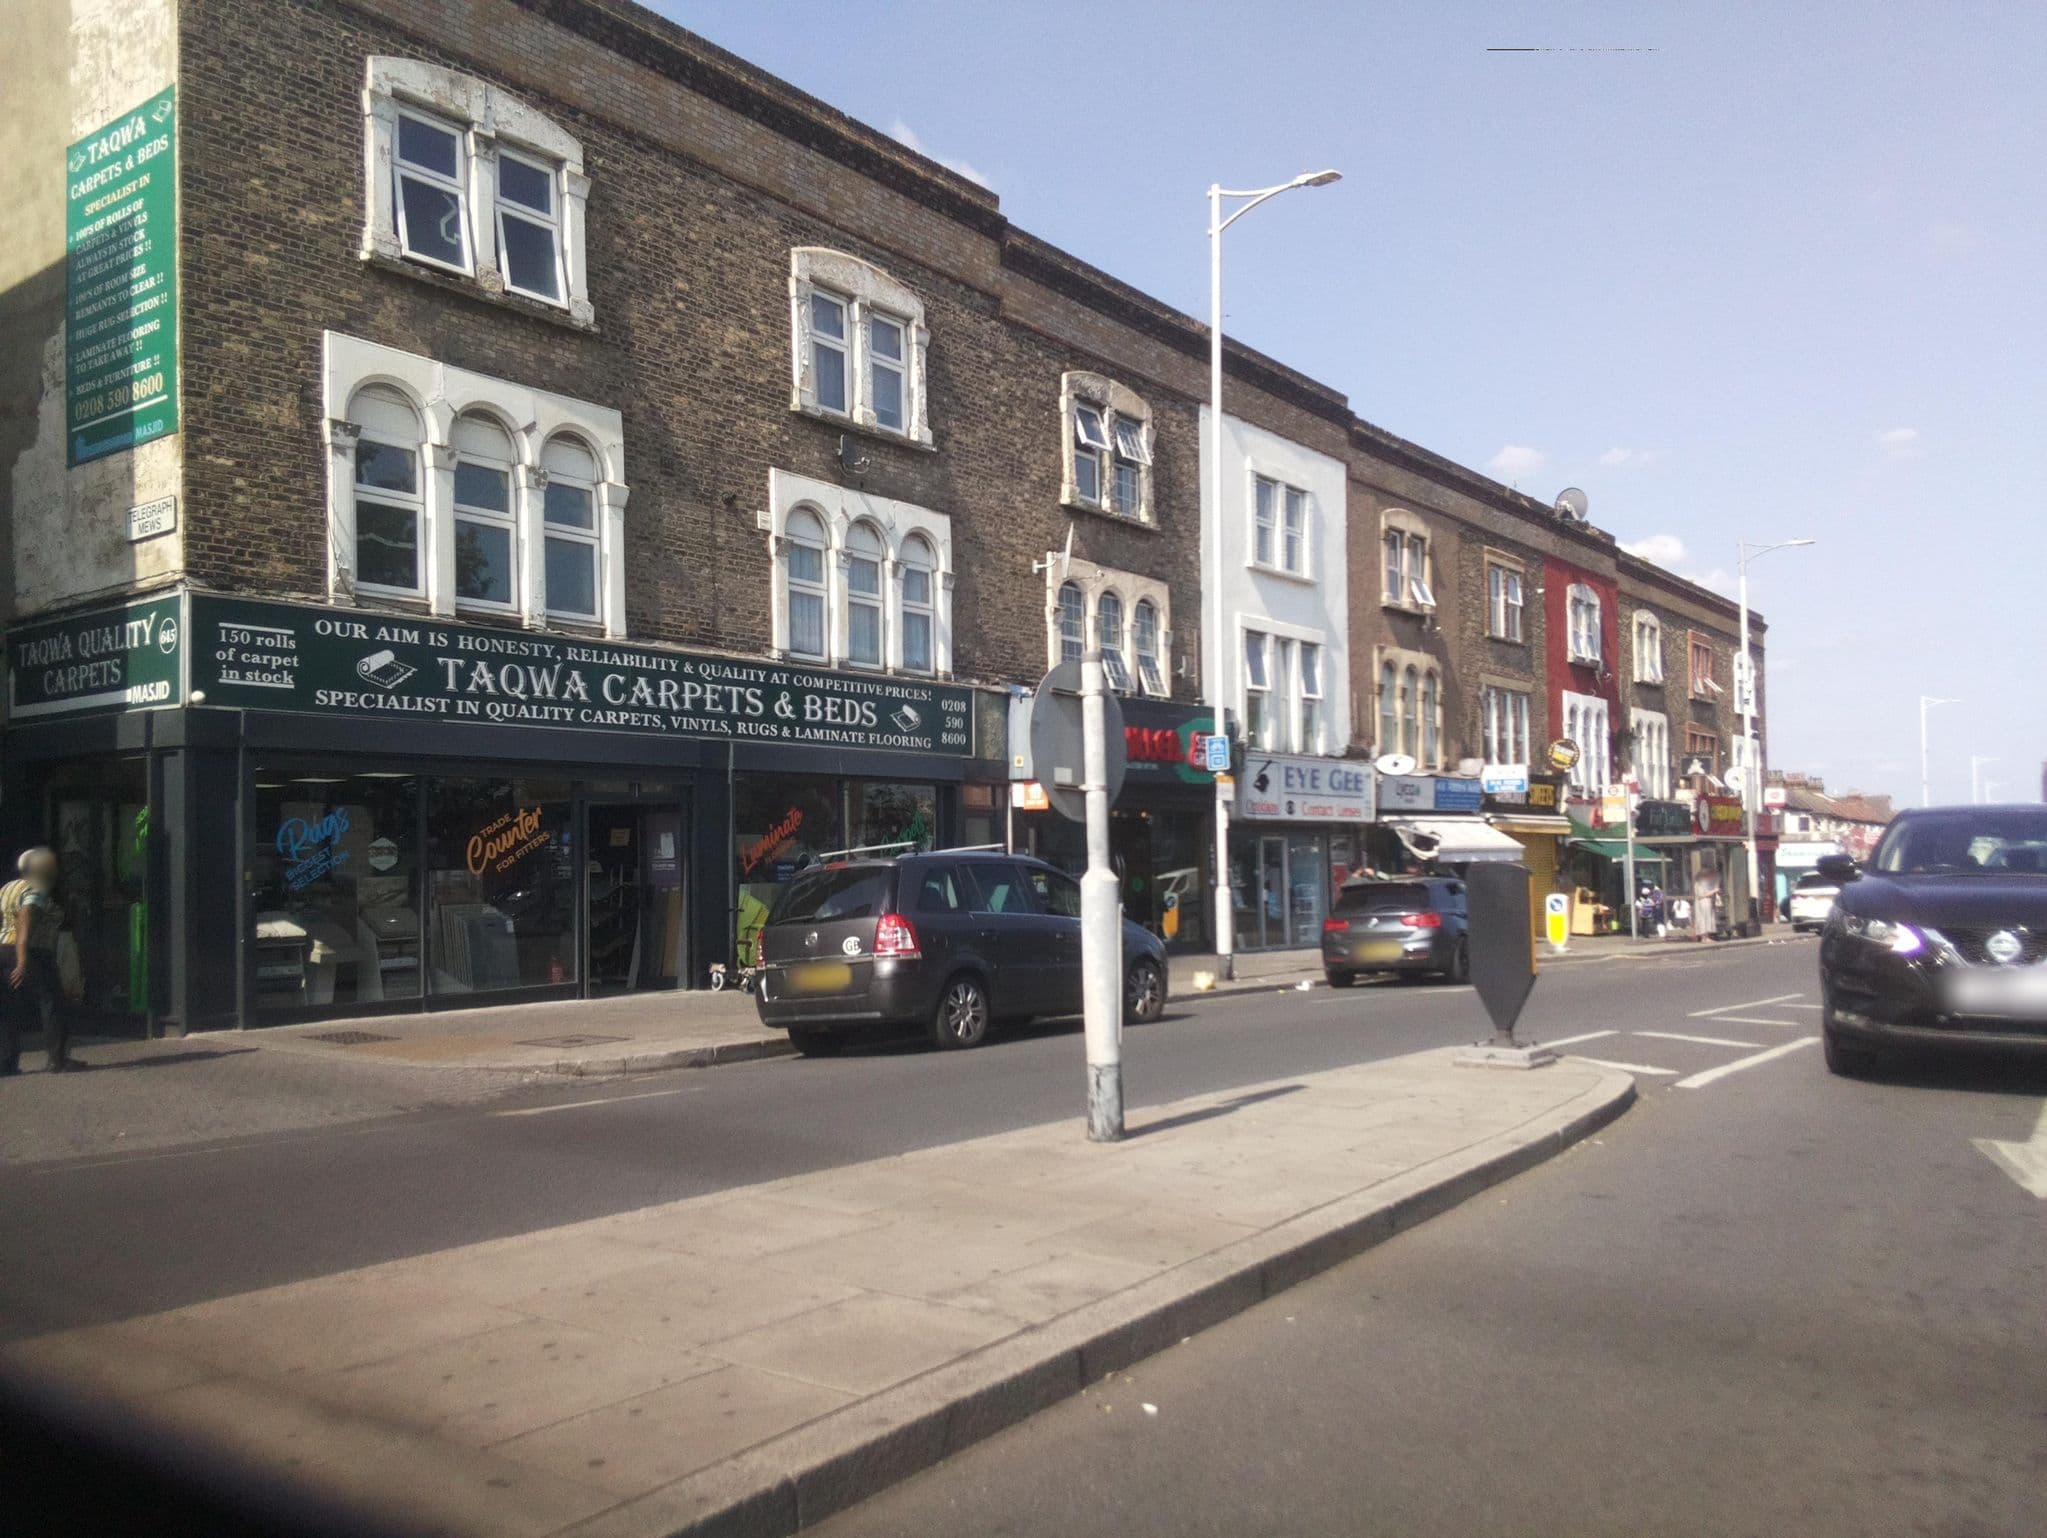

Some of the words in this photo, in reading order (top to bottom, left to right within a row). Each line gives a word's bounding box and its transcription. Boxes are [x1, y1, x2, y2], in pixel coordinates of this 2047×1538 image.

[88, 116, 146, 164] TAQWA
[71, 161, 122, 200] CARPETS
[125, 154, 134, 170] &
[138, 134, 168, 164] BEDS
[84, 180, 138, 216] SPECIALIST
[139, 172, 151, 188] IN
[76, 233, 110, 255] CARPETS
[119, 211, 148, 233] VINYLS
[94, 218, 106, 232] OF
[106, 205, 132, 226] ROLLS
[132, 198, 144, 212] OF
[76, 247, 108, 271] ALWAYS
[108, 244, 118, 253] IN
[119, 228, 146, 247] STOCK
[87, 260, 114, 278] GREAT
[115, 243, 144, 264] PRICES
[104, 272, 128, 292] ROOM
[129, 264, 146, 280] SIZE
[76, 296, 118, 320] REMNANTS
[130, 276, 156, 296] CLEAR
[76, 324, 97, 340] HUGE
[98, 316, 116, 331] RUG
[116, 296, 160, 324] SELECTION
[76, 338, 118, 362] LAMINATE
[118, 319, 160, 346] FLOORING
[76, 362, 87, 374] TO
[88, 352, 110, 370] TAKE
[110, 343, 135, 362] AWAY
[76, 380, 96, 396] BEDS
[103, 358, 152, 386] FURNITURE
[75, 396, 104, 421] 0208
[106, 385, 130, 409] 590
[132, 372, 164, 401] 8600
[136, 419, 164, 440] MASJID
[128, 500, 172, 524] TELEGRAPH
[138, 517, 162, 535] MEWS
[18, 632, 74, 668] TAQWA
[78, 611, 157, 659] QUALITY
[216, 648, 236, 662] of
[241, 651, 300, 668] carpet
[219, 630, 250, 645] 150
[256, 634, 297, 650] rolls
[44, 658, 122, 695] CARPETS
[222, 664, 240, 680] in
[245, 669, 294, 685] stock
[314, 619, 369, 640] OUR
[376, 626, 420, 645] AIM
[428, 631, 449, 648] IS
[457, 634, 562, 662] HONESTY,
[566, 647, 680, 674] RELIABILITY
[683, 661, 694, 674] &
[699, 662, 766, 684] QUALITY
[770, 672, 790, 685] AT
[793, 675, 884, 697] COMPETITIVE
[885, 685, 932, 702] PRICES!
[132, 680, 170, 704] MASJID
[436, 656, 592, 703] TAQWA
[602, 673, 764, 718] CARPETS
[774, 691, 796, 720] &
[803, 694, 879, 729] BEDS
[941, 700, 967, 713] 0208
[314, 689, 450, 713] SPECIALIST
[456, 700, 480, 715] IN
[486, 701, 576, 723] QUALITY
[580, 708, 667, 732] CARPETS,
[671, 716, 733, 735] VINYLS,
[736, 721, 778, 738] RUGS
[781, 726, 791, 738] &
[795, 727, 865, 746] LAMINATE
[868, 733, 932, 749] FLOORING
[945, 716, 964, 729] 590
[941, 732, 967, 746] 8600
[1284, 766, 1320, 790] EYE
[1328, 768, 1364, 793] GEE
[276, 807, 350, 860] Rugs
[467, 806, 543, 876] Counter
[480, 813, 512, 838] TRADE
[496, 855, 515, 873] FOR
[516, 831, 551, 860] FITTERS
